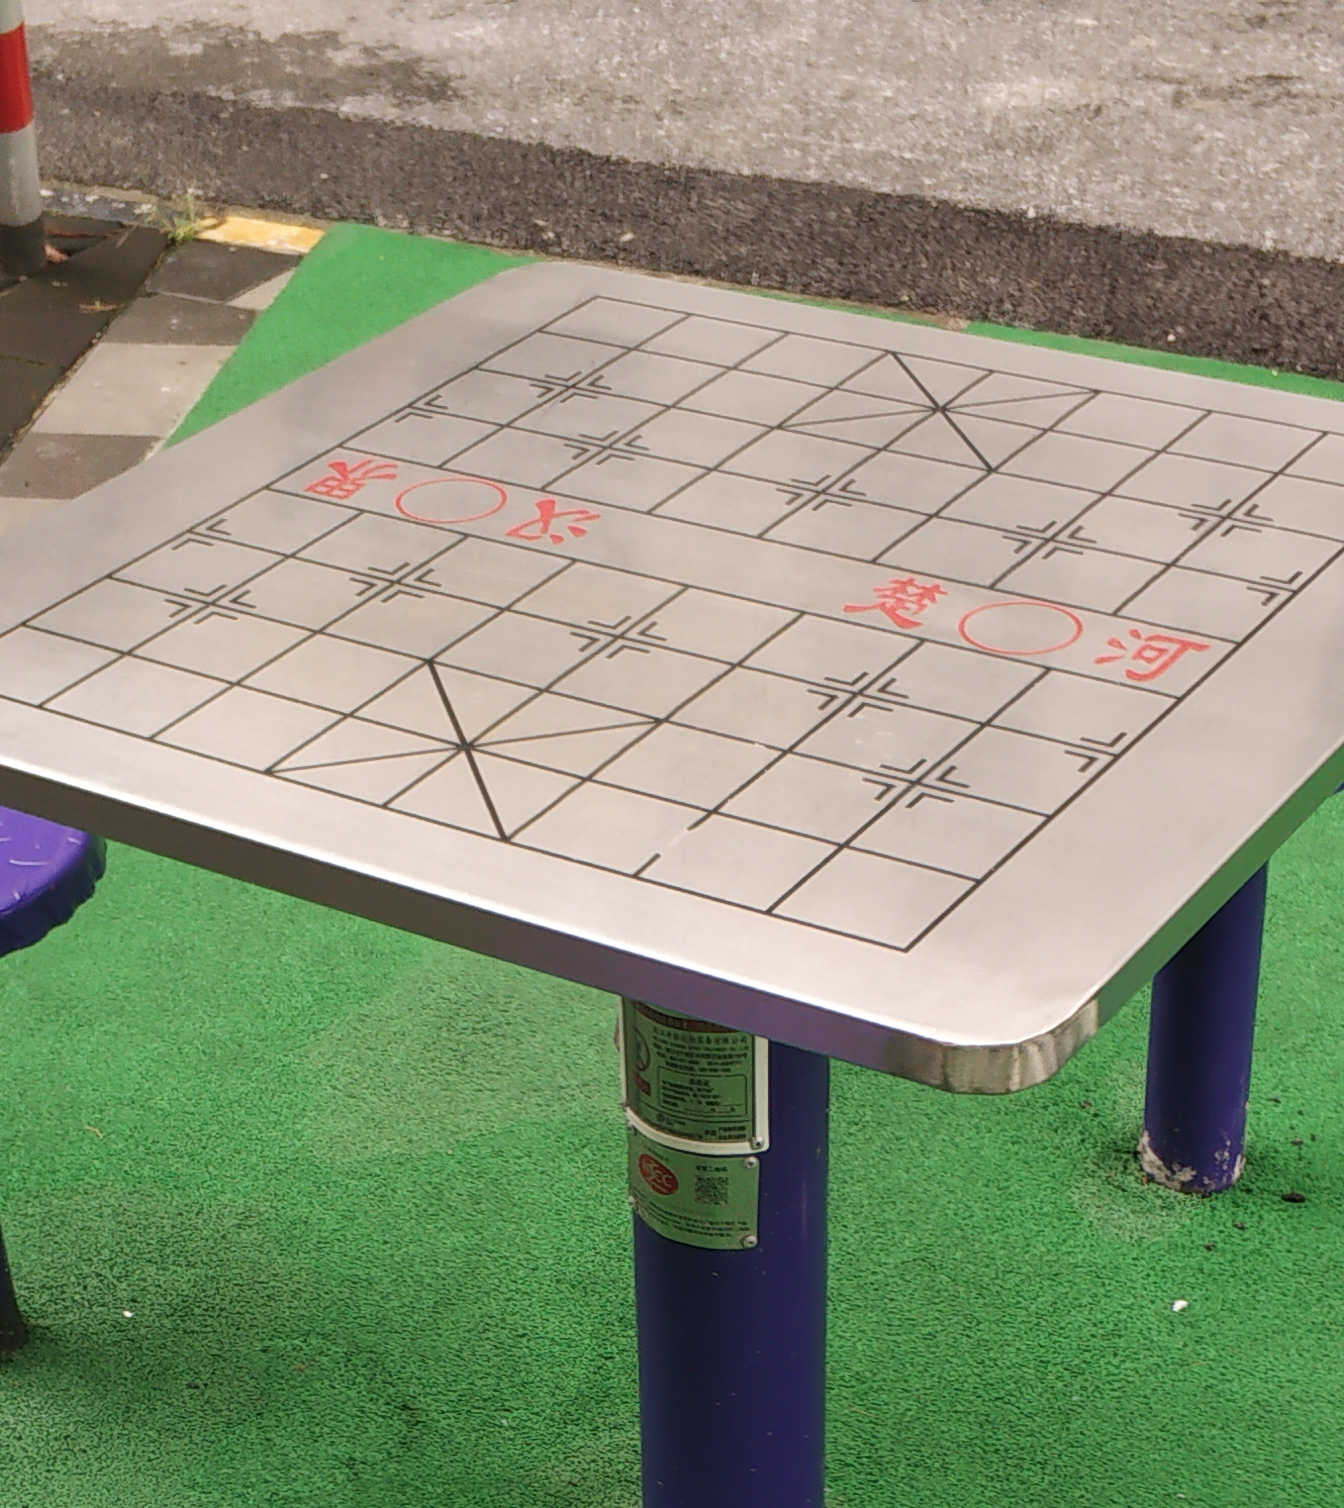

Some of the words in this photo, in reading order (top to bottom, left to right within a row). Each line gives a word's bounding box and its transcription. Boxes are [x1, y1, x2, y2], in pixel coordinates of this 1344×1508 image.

[304, 458, 398, 500] 界
[505, 497, 600, 545] 汉
[843, 576, 948, 629] 楚
[1094, 628, 1211, 682] 河
